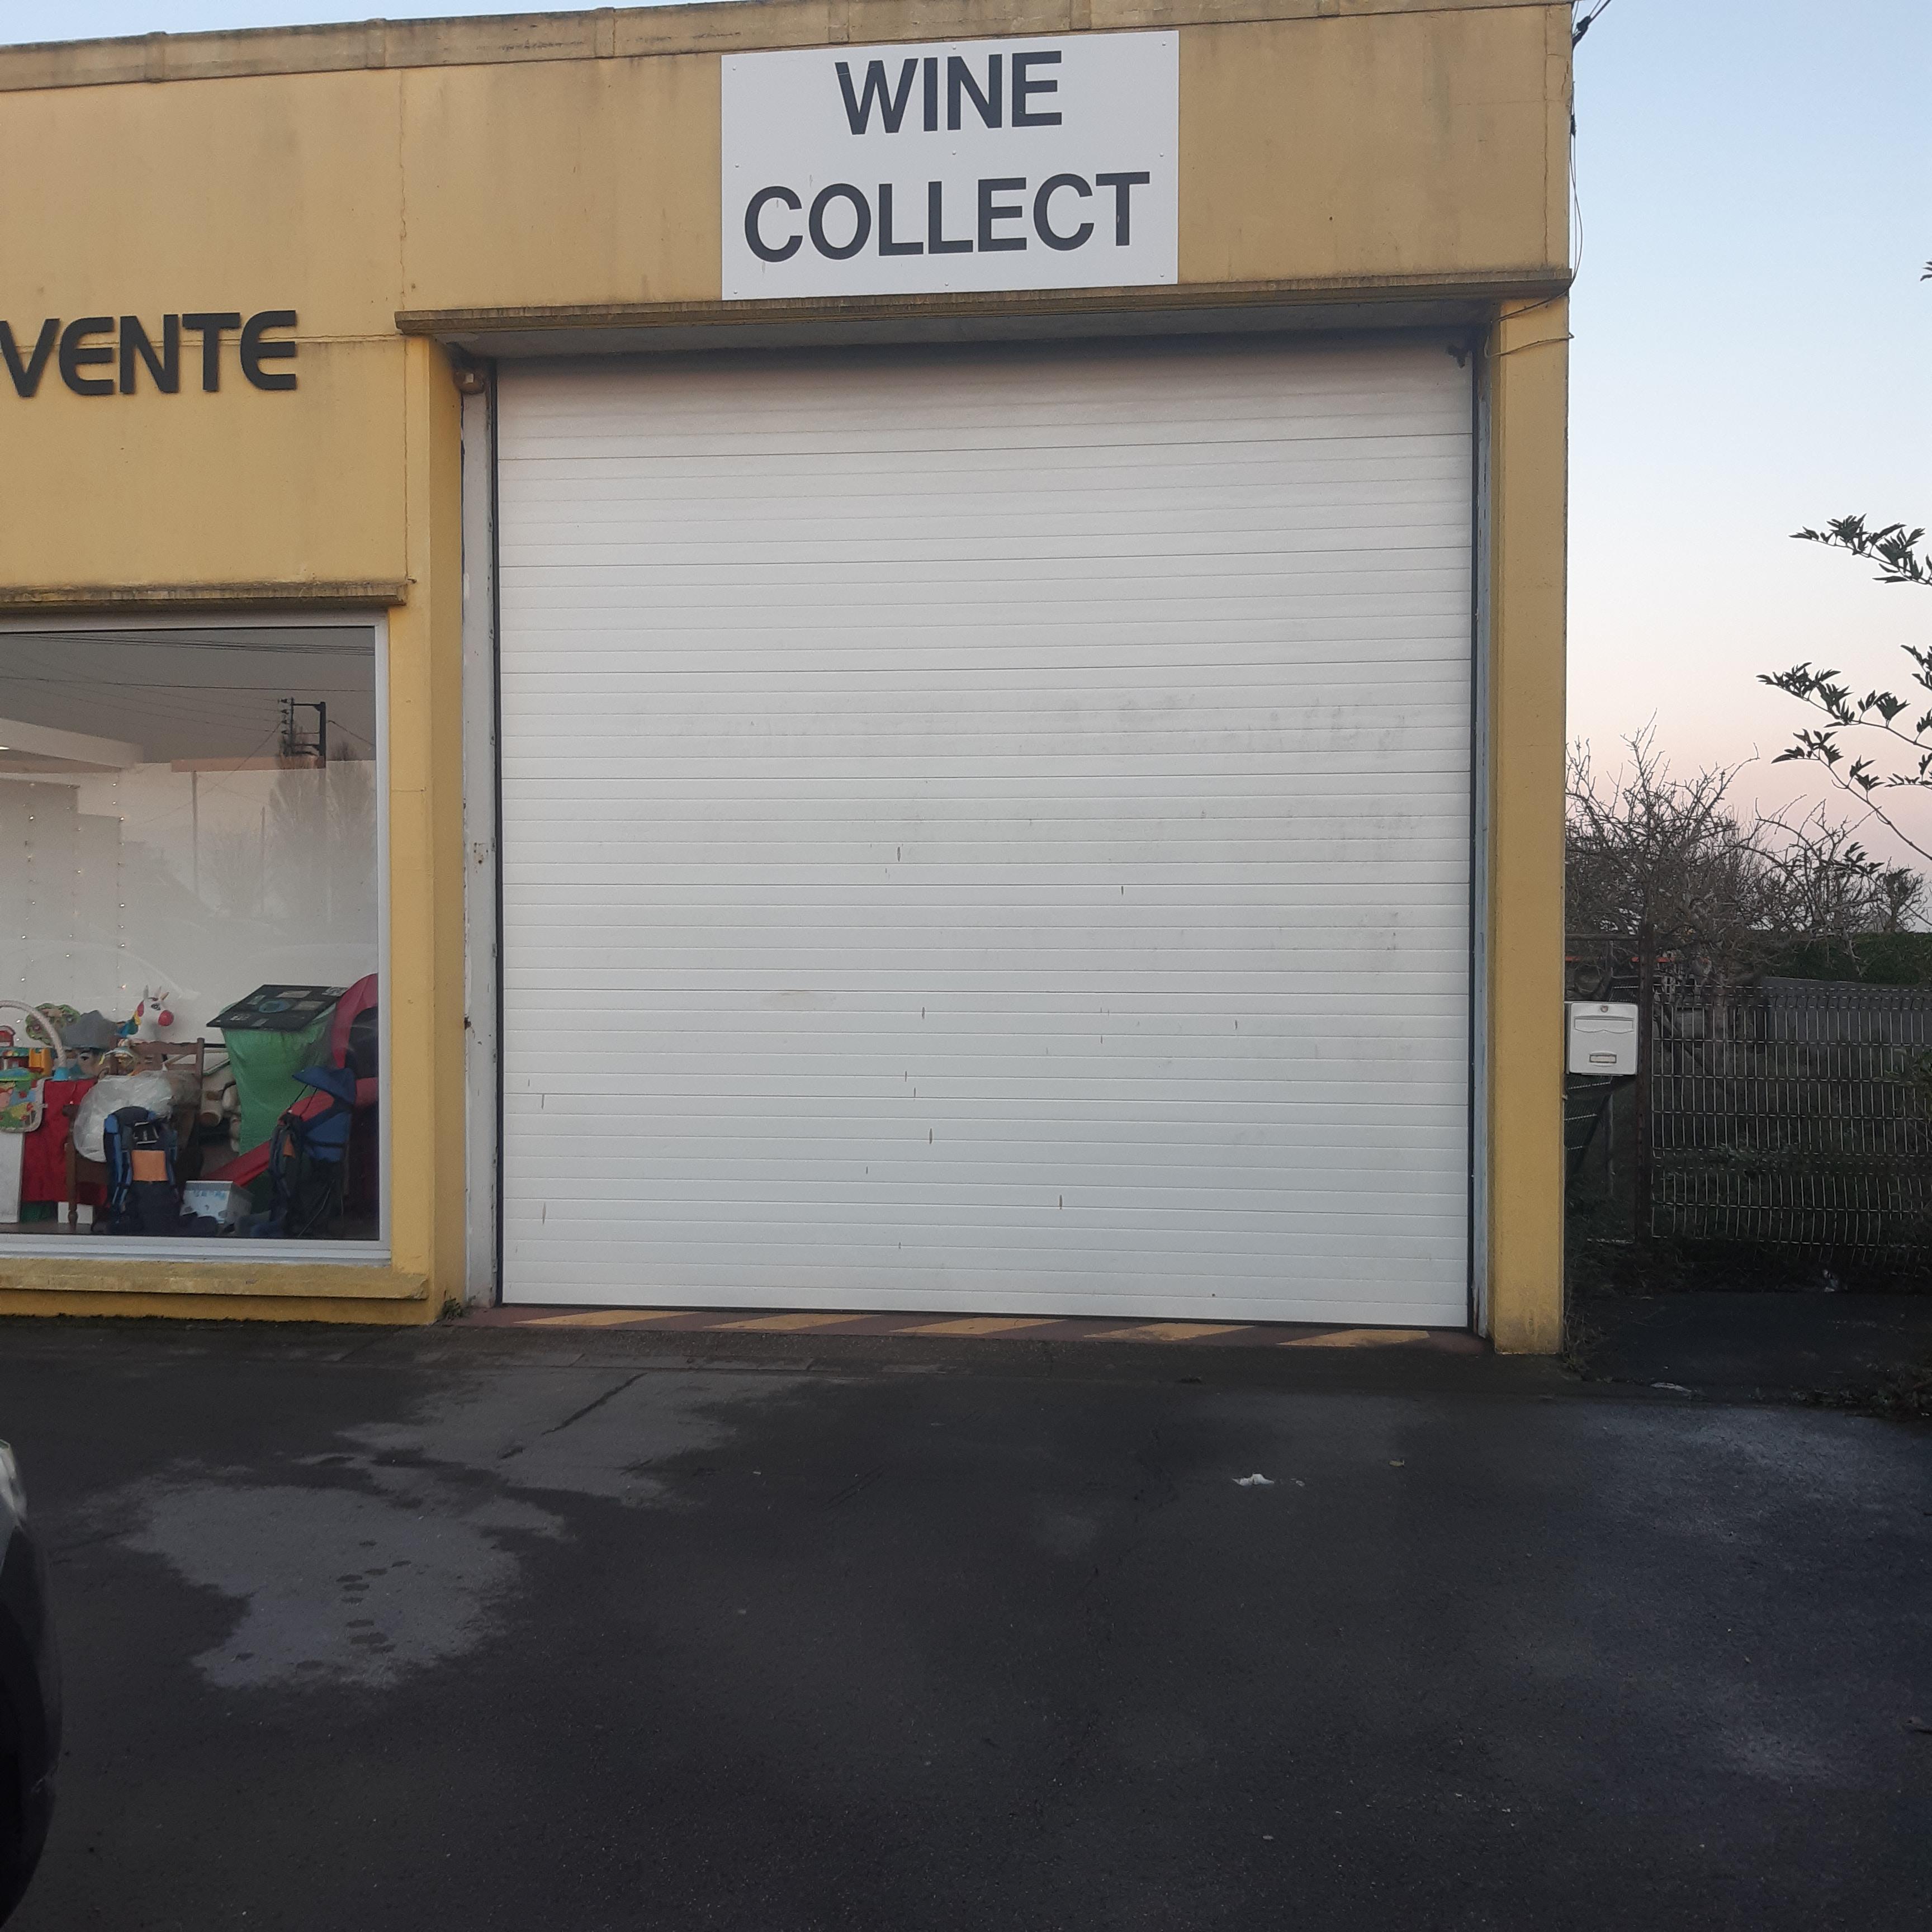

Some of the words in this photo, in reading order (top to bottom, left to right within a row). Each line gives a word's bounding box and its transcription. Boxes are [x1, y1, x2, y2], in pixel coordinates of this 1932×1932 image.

[835, 50, 1062, 135] WINE
[744, 171, 1150, 263] COLLECT
[0, 310, 298, 398] VENTE
